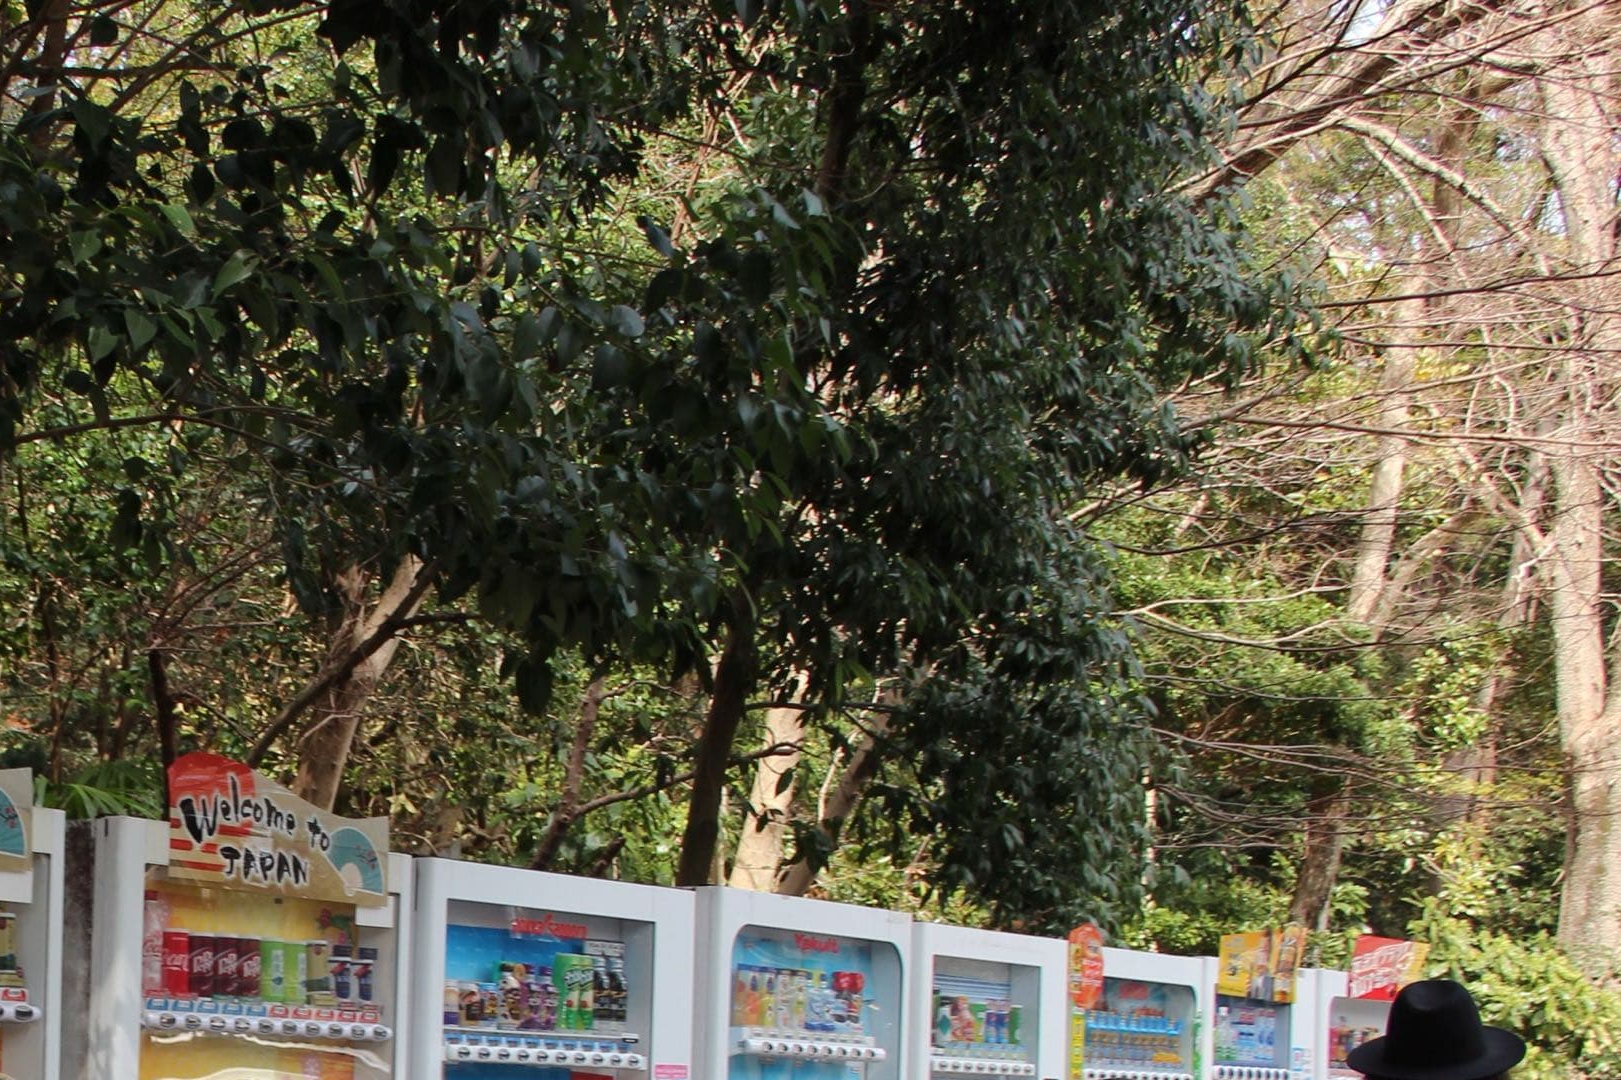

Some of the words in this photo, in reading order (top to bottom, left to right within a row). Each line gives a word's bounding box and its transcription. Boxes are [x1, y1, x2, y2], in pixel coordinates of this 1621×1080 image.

[180, 775, 296, 844] Welcome
[306, 818, 330, 851] to
[220, 846, 308, 885] JAPAN
